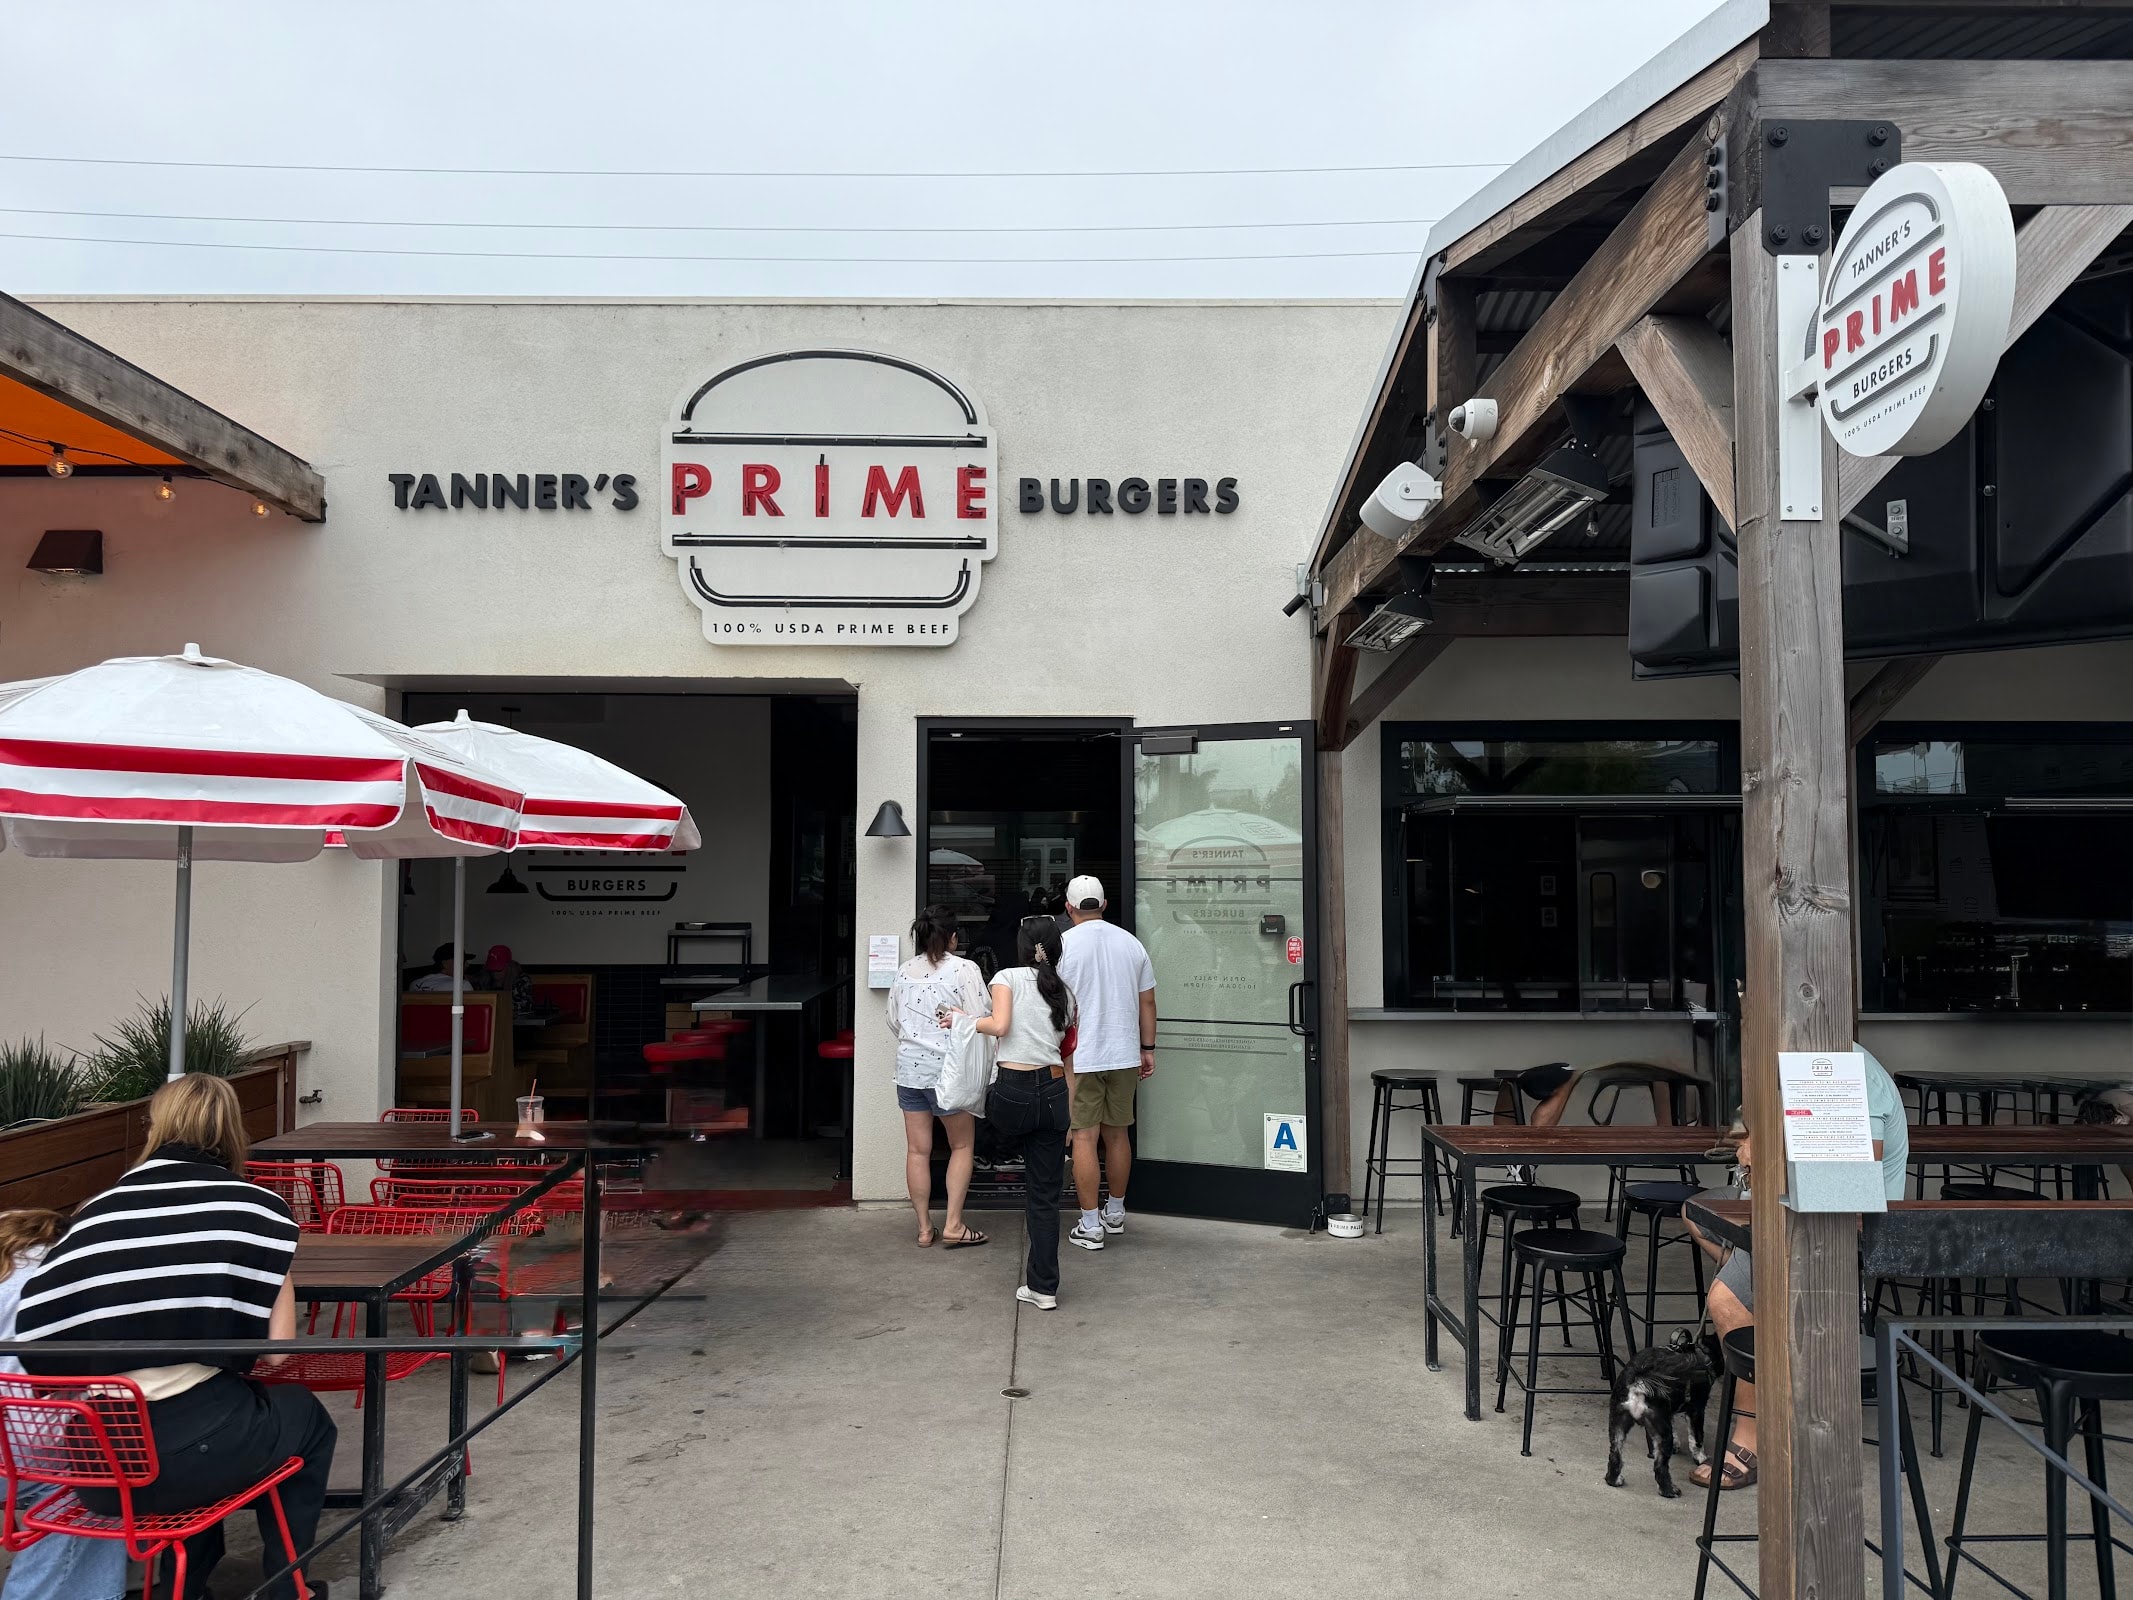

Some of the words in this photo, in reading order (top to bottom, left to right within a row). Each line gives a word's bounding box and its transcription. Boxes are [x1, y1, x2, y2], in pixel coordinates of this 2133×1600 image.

[1851, 219, 1912, 279] TANNER'S
[1823, 246, 1946, 369] PRIME
[1852, 348, 1913, 399] BURGERS
[1844, 424, 1861, 439] 100%
[1863, 412, 1881, 430] USDA
[1884, 398, 1906, 416] PRIME
[1909, 385, 1927, 402] BEEF
[388, 472, 639, 512] TANNER'S
[671, 462, 988, 519] PRIME
[1019, 477, 1240, 516] BURGERS
[712, 622, 762, 636] 100%
[775, 623, 825, 636] USDA
[836, 623, 896, 636] PRIME
[907, 623, 950, 636] BEEF
[567, 879, 647, 891] BURGERS
[1273, 1122, 1298, 1150] A
